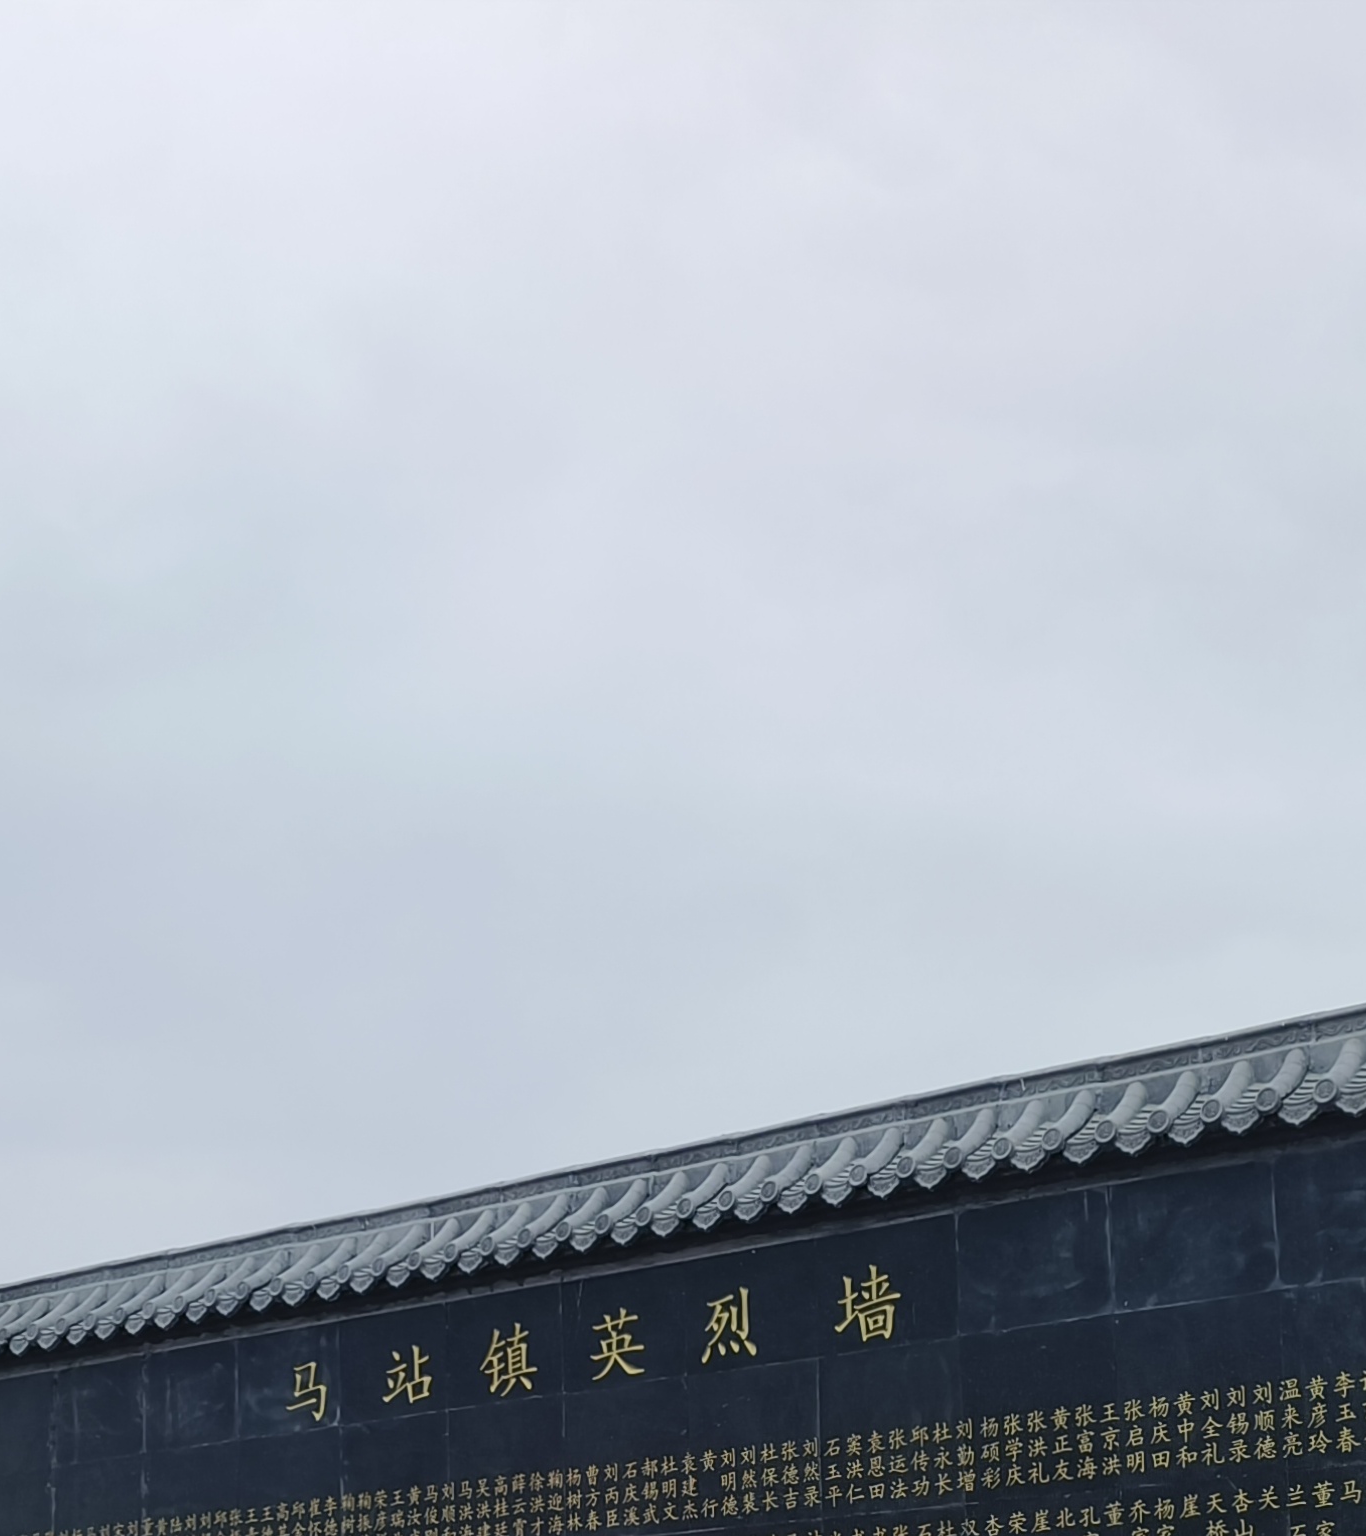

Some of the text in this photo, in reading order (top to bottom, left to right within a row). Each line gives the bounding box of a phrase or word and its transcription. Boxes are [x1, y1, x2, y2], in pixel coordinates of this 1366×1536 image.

[285, 1264, 902, 1421] 马站镇英烈墙
[1027, 1410, 1049, 1483] 张洪礼
[1051, 1406, 1072, 1480] 黄正友
[1075, 1404, 1096, 1479] 张富海
[1100, 1402, 1120, 1475] 王京洪
[1124, 1399, 1145, 1472] 张启明
[1149, 1396, 1170, 1467] 杨庆田
[1174, 1391, 1197, 1467] 黄中和
[1201, 1388, 1224, 1465] 刘全礼
[1226, 1385, 1249, 1462] 刘锡录
[1253, 1381, 1275, 1459] 刘顺德
[1279, 1377, 1302, 1457] 温来亮
[1306, 1375, 1330, 1453] 黄彦玲
[1335, 1371, 1358, 1452] 李玉春
[700, 1449, 718, 1518] 黄行
[720, 1448, 737, 1515] 刘明德
[760, 1443, 778, 1511] 杜保长
[781, 1440, 798, 1509] 张德吉
[803, 1437, 820, 1507] 刘然录
[824, 1437, 842, 1506] 石玉平
[867, 1430, 884, 1499] 袁恩田
[888, 1428, 907, 1498] 张运法
[910, 1425, 929, 1496] 邱传功
[933, 1422, 952, 1495] 杜永长
[980, 1416, 1000, 1488] 杨硕彩
[1003, 1413, 1023, 1485] 张学庆
[604, 1462, 619, 1527] 刘丙臣
[641, 1457, 659, 1524] 郝锡武
[661, 1455, 678, 1520] 杜明文
[681, 1452, 697, 1519] 袁建杰
